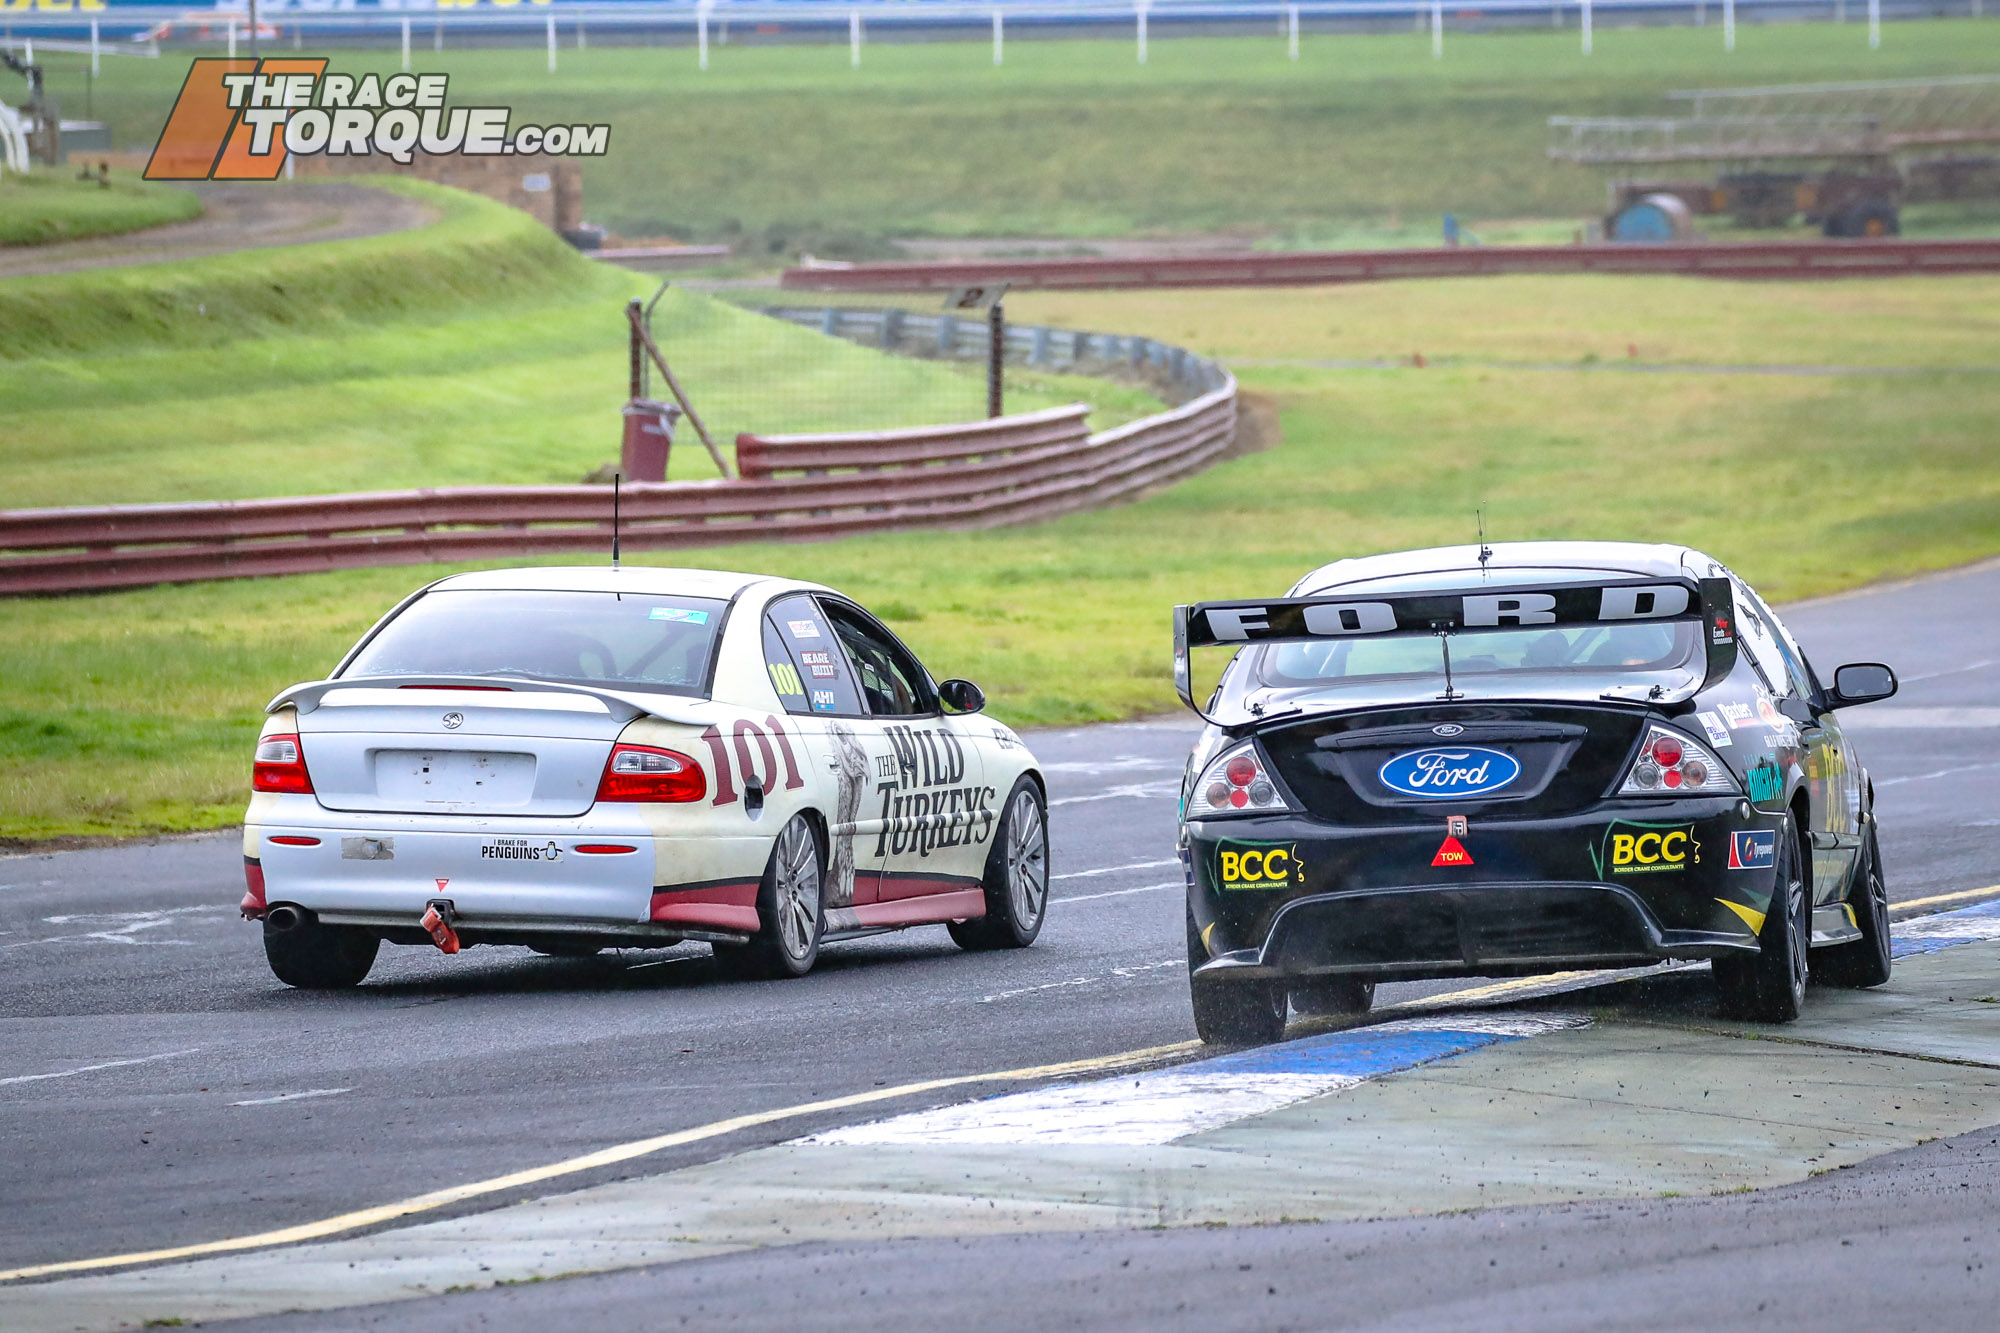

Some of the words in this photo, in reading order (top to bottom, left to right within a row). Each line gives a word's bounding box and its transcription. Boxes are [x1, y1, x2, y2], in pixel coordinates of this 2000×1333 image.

[958, 286, 985, 308] 2
[1205, 585, 1688, 641] FORD
[801, 653, 830, 664] BEARE
[769, 663, 803, 695] 101
[1439, 725, 1457, 734] Ford
[701, 714, 805, 807] 101
[874, 754, 898, 778] THE
[882, 724, 965, 790] WILD
[1408, 752, 1491, 788] Ford
[874, 780, 996, 858] TURKEYS
[481, 846, 540, 860] PENGUINS
[1441, 852, 1464, 862] TOW
[1613, 831, 1687, 864] BCC
[1221, 849, 1288, 881] BCC
[1651, 864, 1685, 872] CONSULTANTS
